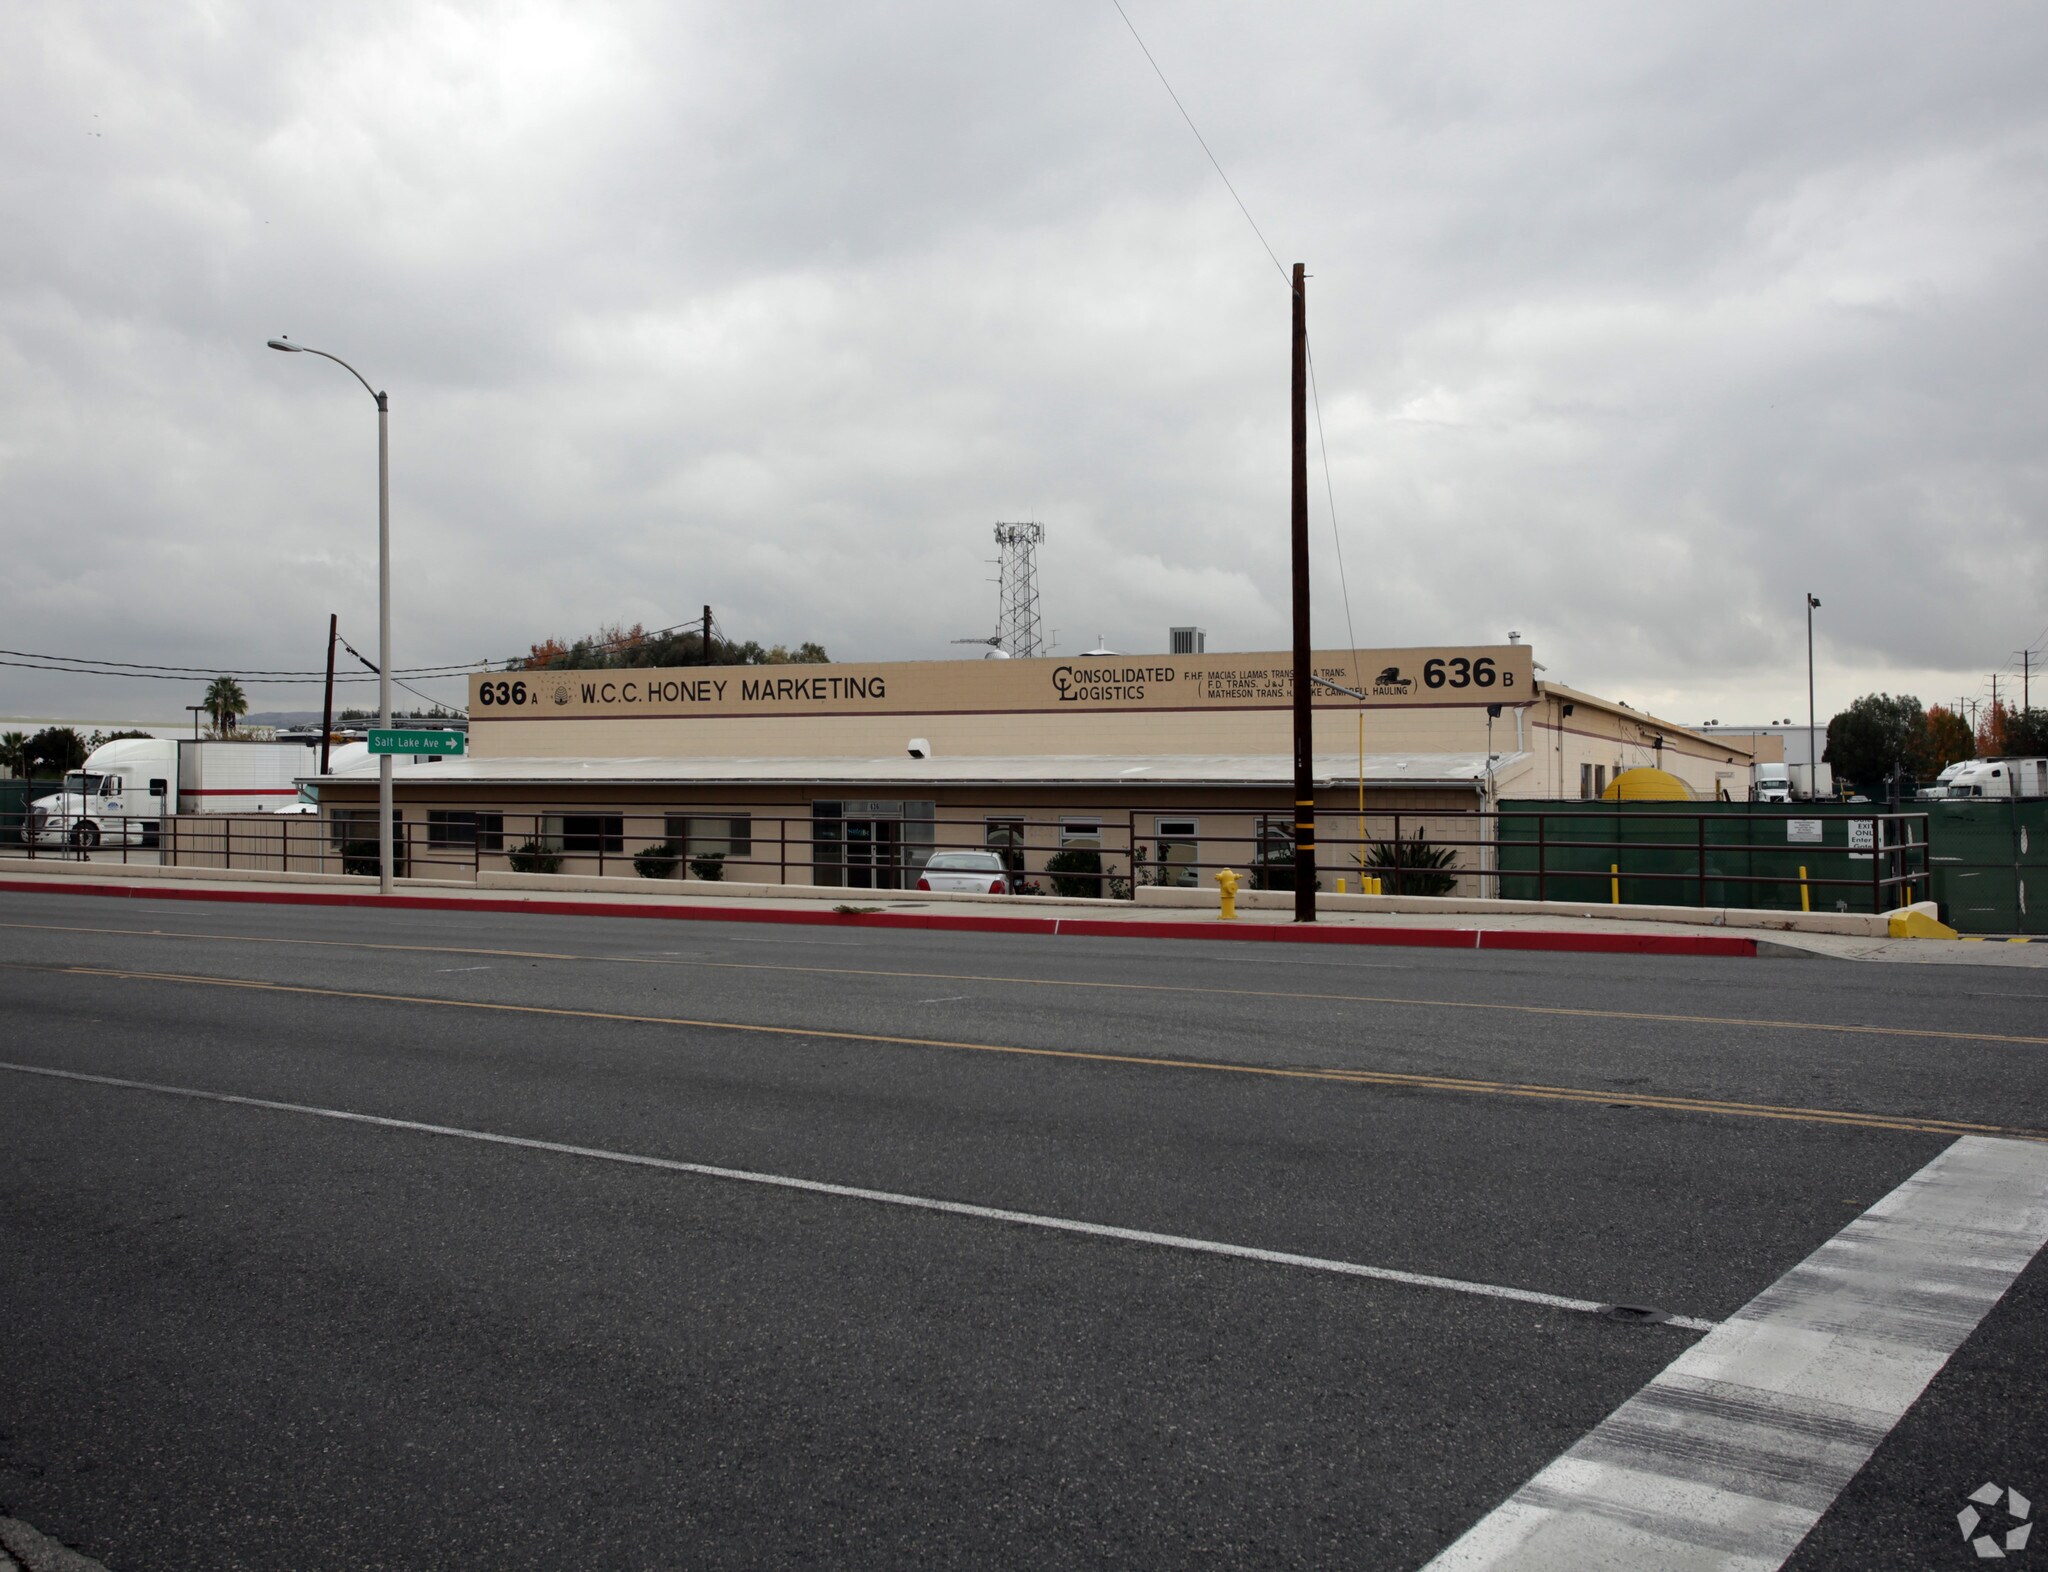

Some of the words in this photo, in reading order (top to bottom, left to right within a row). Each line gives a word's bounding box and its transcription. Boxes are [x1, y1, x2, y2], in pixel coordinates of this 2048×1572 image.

[1208, 671, 1236, 680] MACIAS
[1239, 671, 1268, 679] LLAMAS
[1321, 669, 1346, 677] TRANS.
[1424, 657, 1497, 688] 636
[1227, 679, 1258, 688] TRANS.
[1502, 672, 1514, 687] B
[479, 681, 527, 706] 636
[581, 683, 642, 703] W.C.C.
[648, 680, 728, 702] HONEY
[742, 677, 886, 701] MARKETING
[1208, 689, 1253, 699] MATHESON
[1372, 686, 1408, 695] HAULING
[531, 693, 538, 705] A
[375, 736, 394, 747] Salt
[398, 737, 420, 747] Lake
[423, 738, 439, 748] Ave
